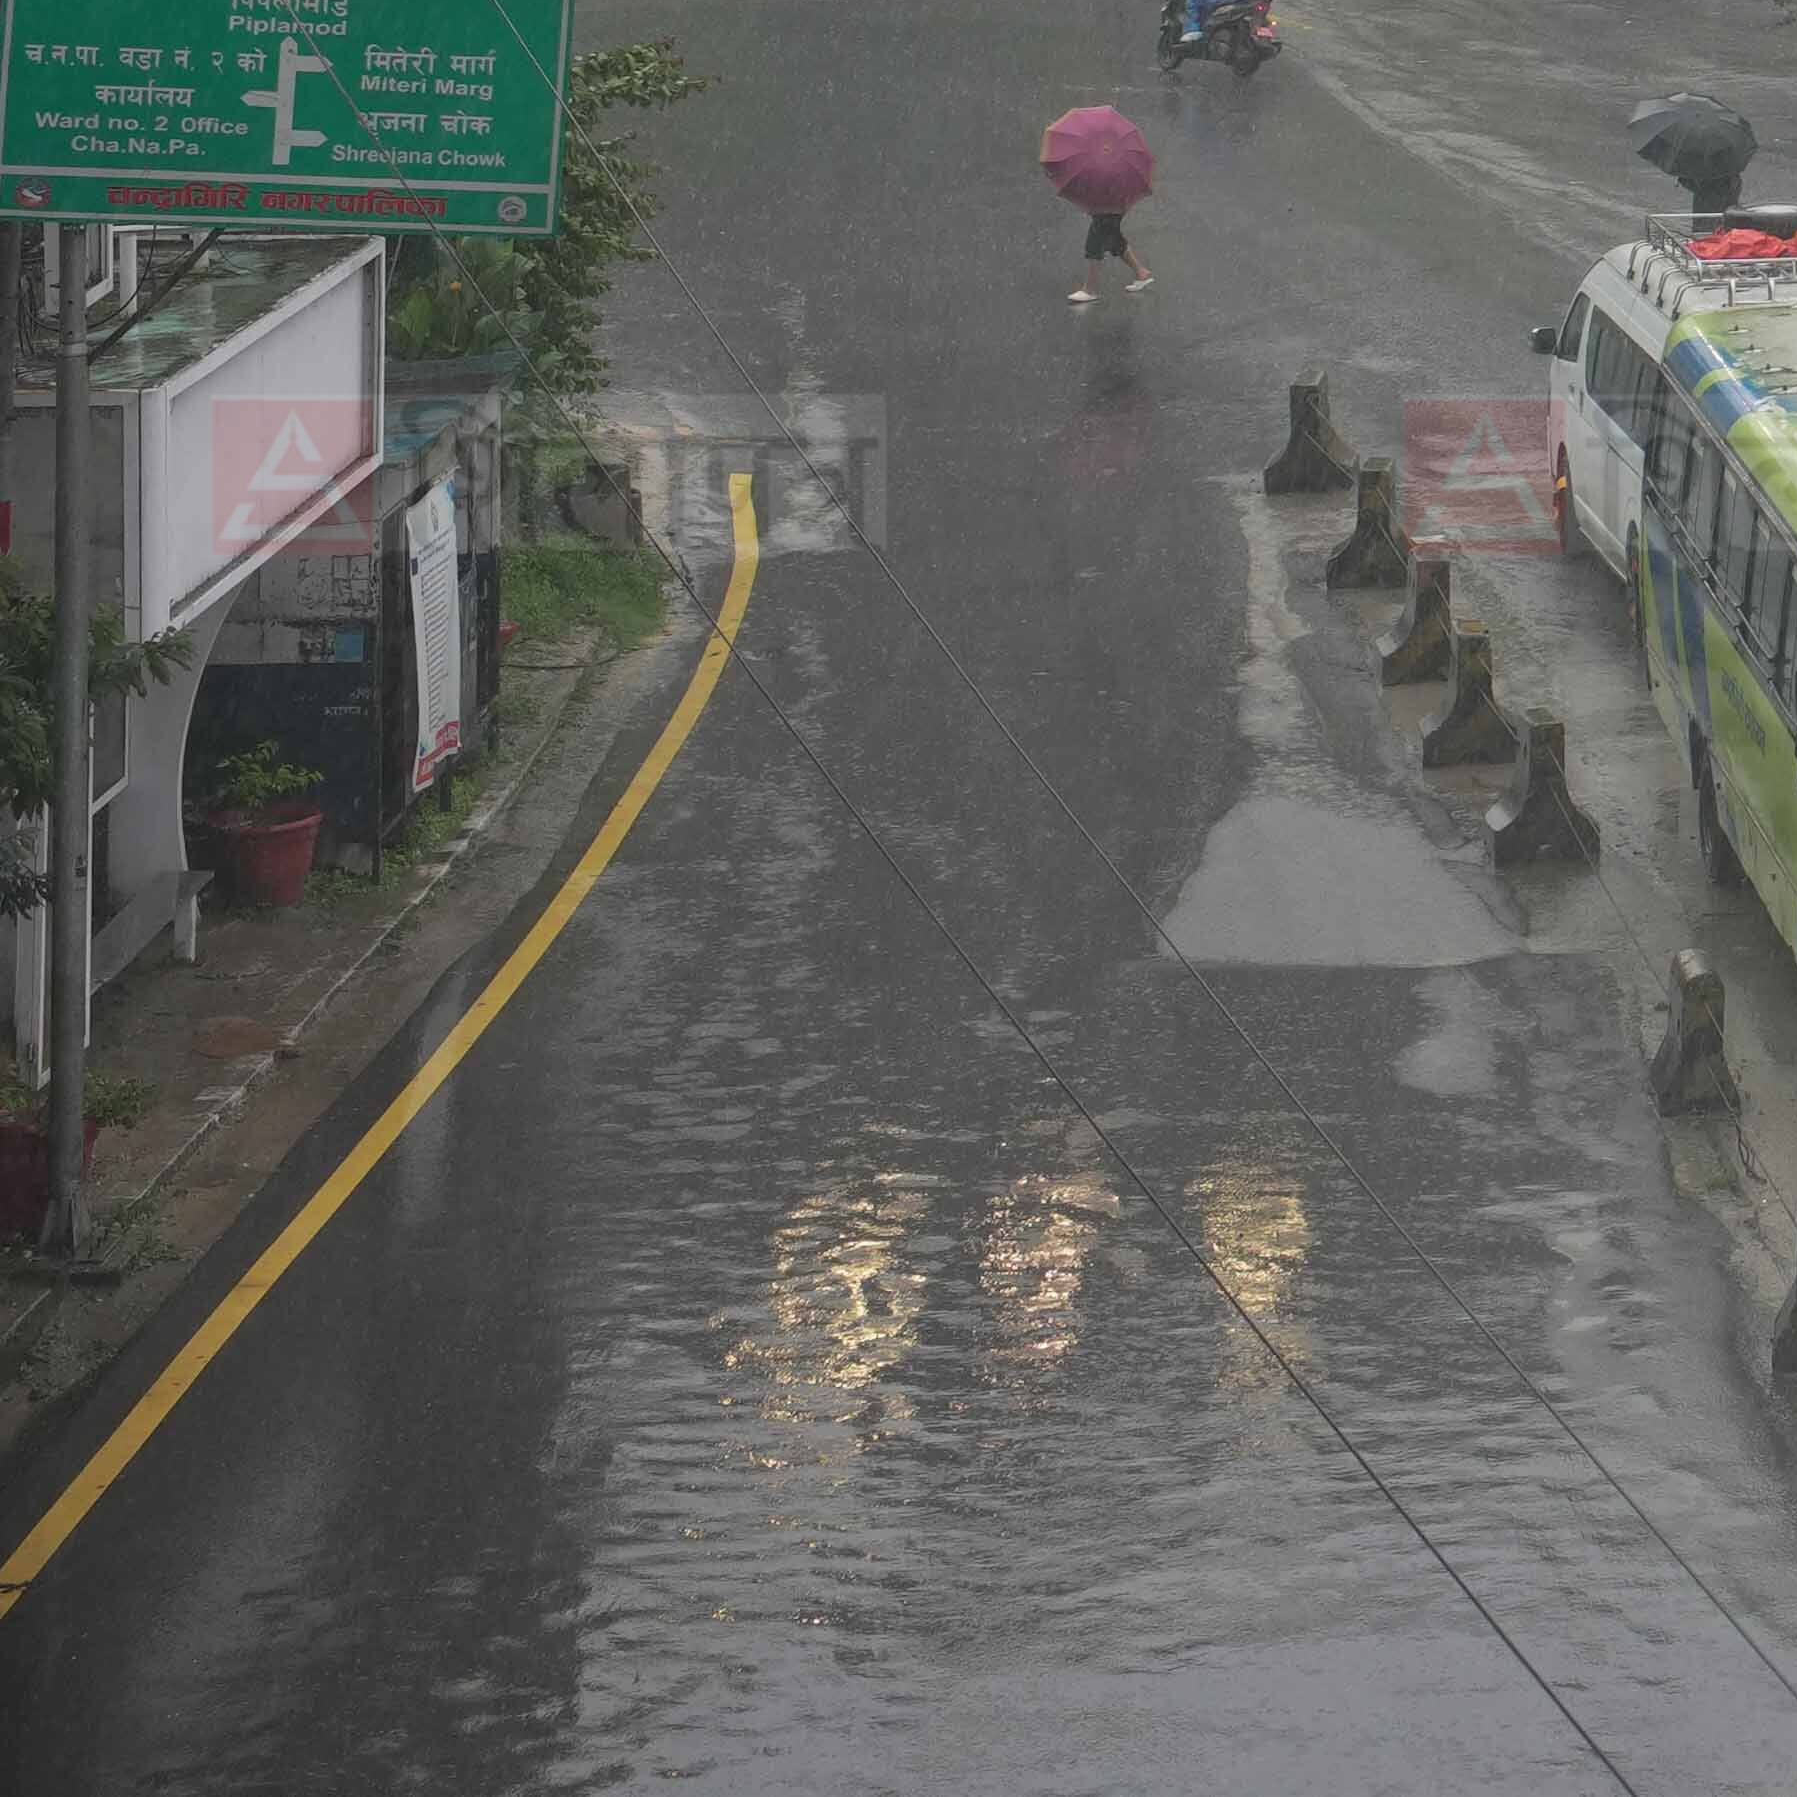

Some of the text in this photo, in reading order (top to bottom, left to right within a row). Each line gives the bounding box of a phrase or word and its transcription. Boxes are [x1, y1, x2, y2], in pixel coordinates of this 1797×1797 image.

[229, 15, 347, 36] Piplamod
[119, 47, 163, 70] वडा
[211, 51, 224, 75] २
[237, 48, 268, 72] को
[364, 44, 497, 76] मितेरी मार्ग
[95, 80, 196, 107] कार्यालय
[360, 75, 493, 100] Miteri Marg
[35, 112, 248, 134] Ward no. 2 Office
[440, 110, 493, 135] चोक
[71, 135, 206, 156] Cha.Na.Pa.
[332, 145, 505, 167] Shreejana Chowk
